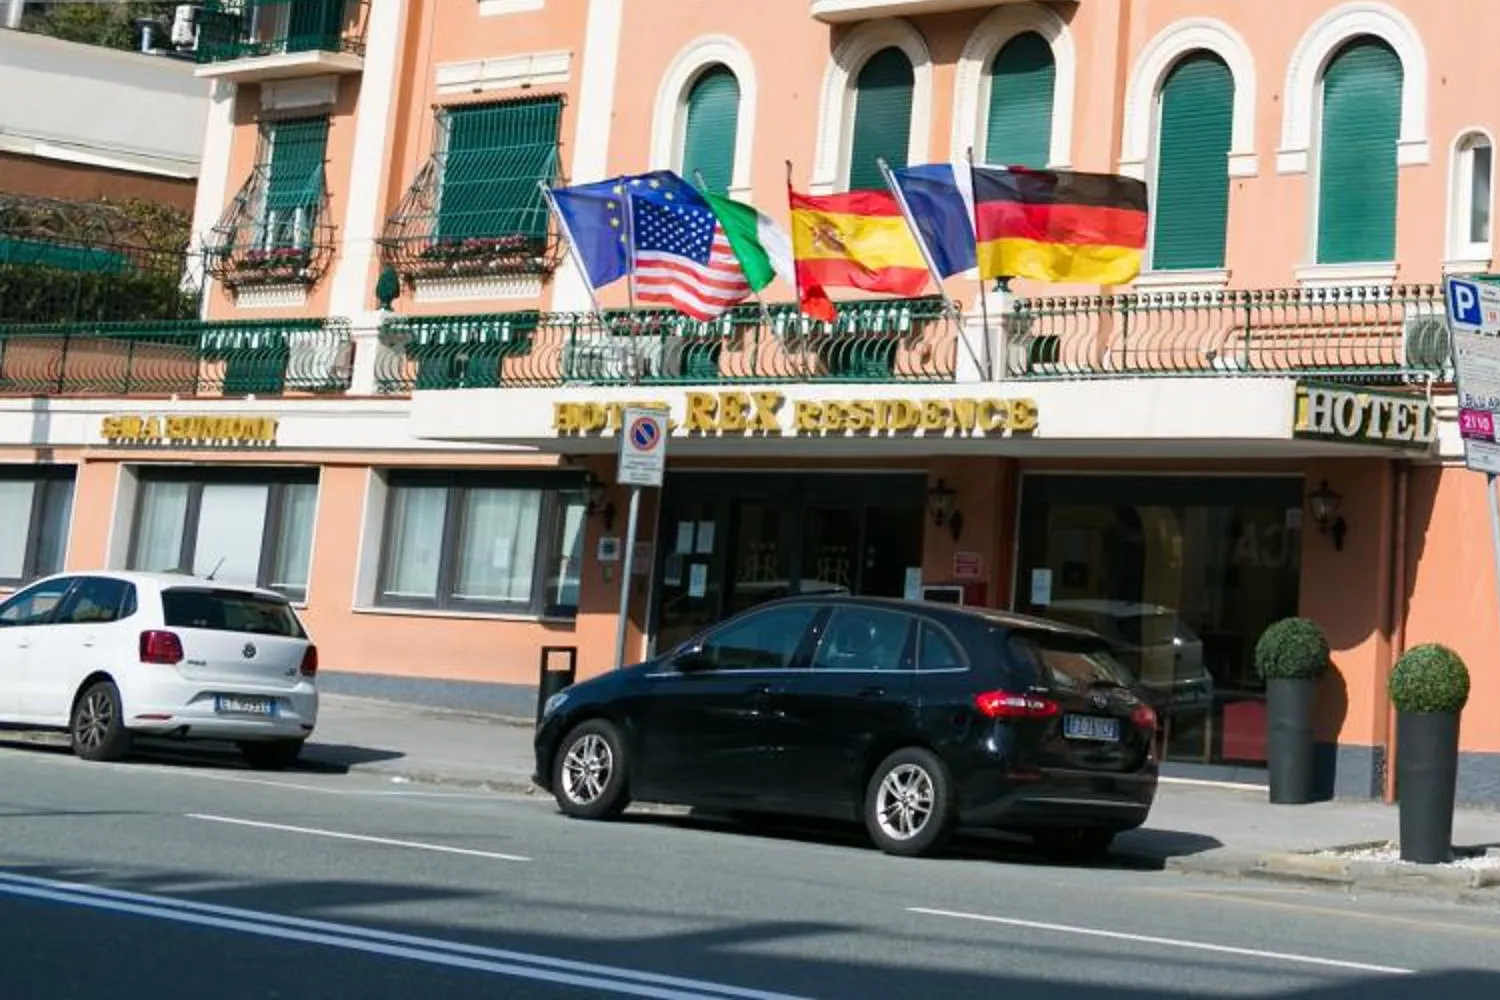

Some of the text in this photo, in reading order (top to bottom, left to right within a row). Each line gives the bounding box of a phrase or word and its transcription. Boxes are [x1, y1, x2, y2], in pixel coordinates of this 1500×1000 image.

[1456, 284, 1475, 320] P
[551, 391, 1038, 432] HOT REX RESIDENCE
[1304, 387, 1438, 444] HOTEL
